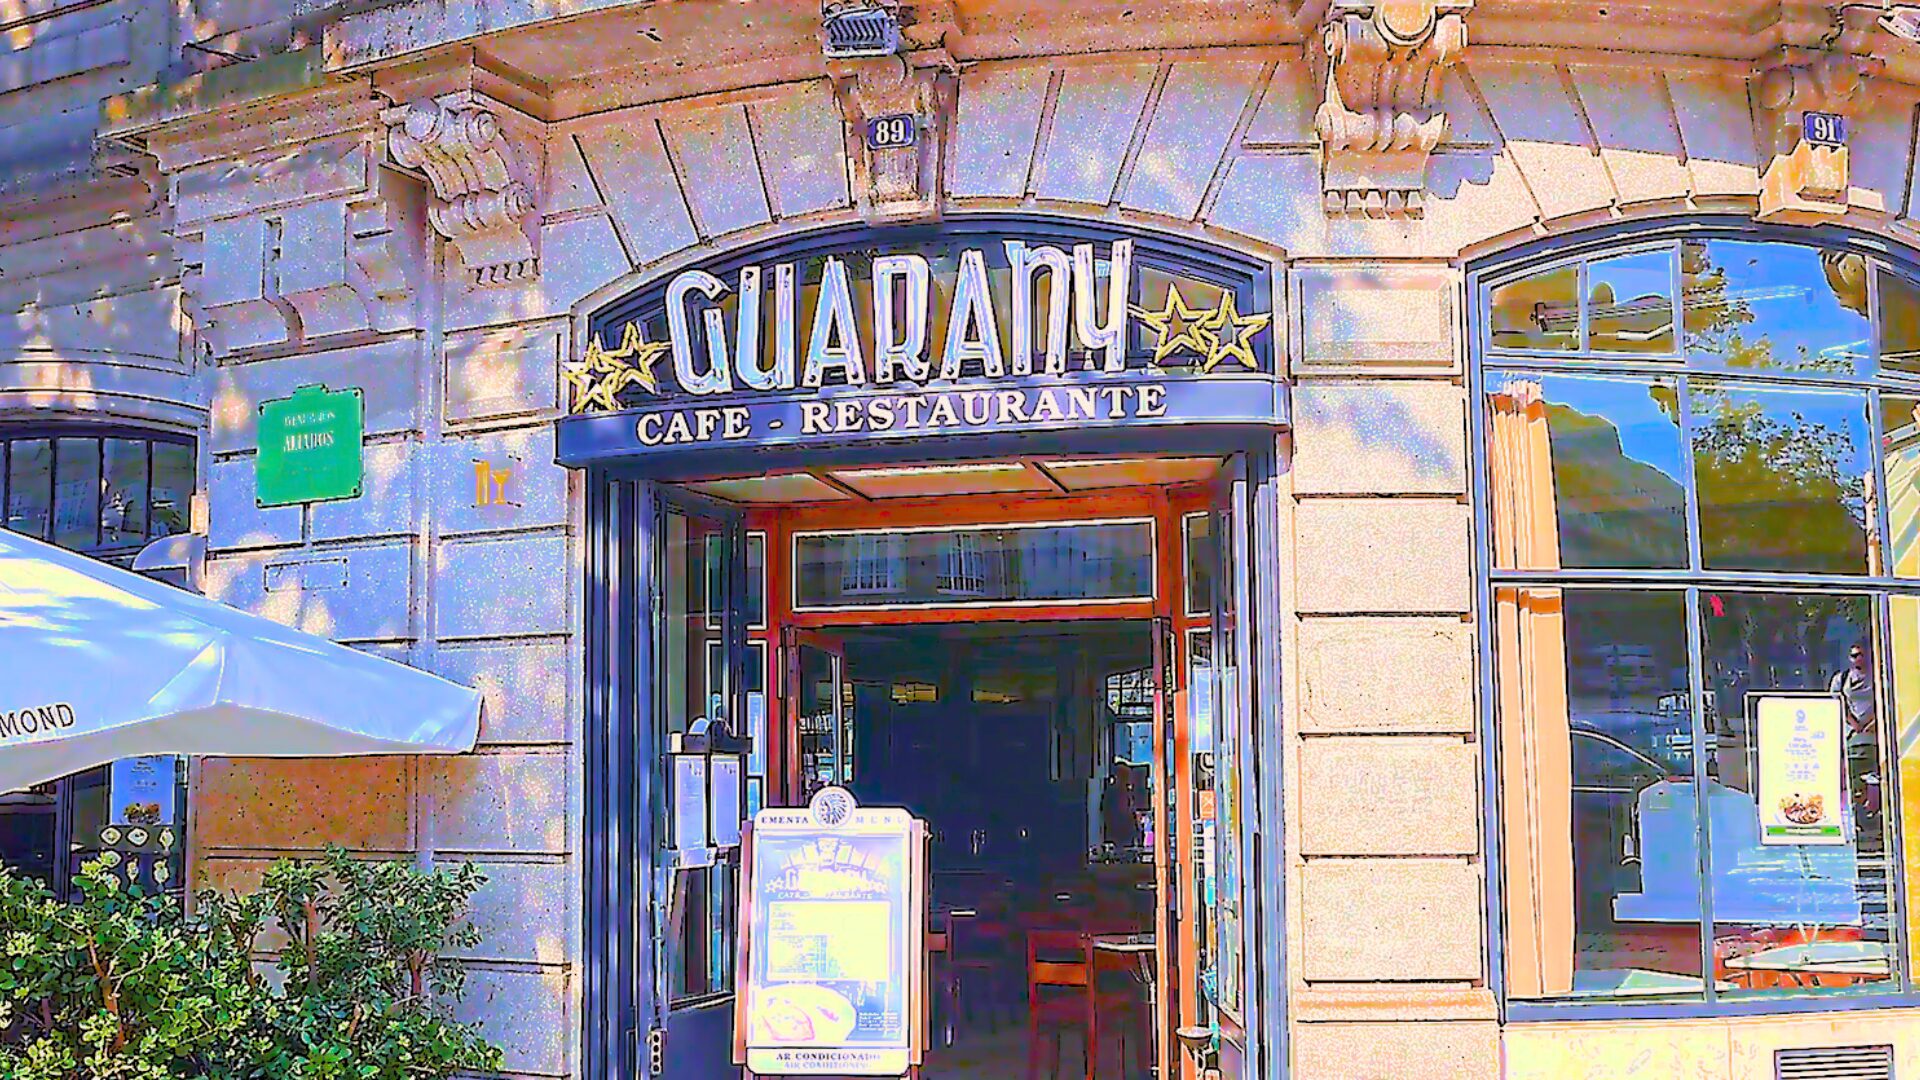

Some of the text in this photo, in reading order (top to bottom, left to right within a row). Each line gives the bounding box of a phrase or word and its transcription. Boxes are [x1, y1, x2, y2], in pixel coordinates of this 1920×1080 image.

[875, 119, 905, 144] 89
[1814, 117, 1836, 141] 91
[665, 239, 1133, 395] GUARANY
[636, 406, 752, 446] CAFE
[800, 384, 1169, 435] RESTAURANTE
[761, 816, 809, 825] EMENTA
[776, 1052, 791, 1061] AR
